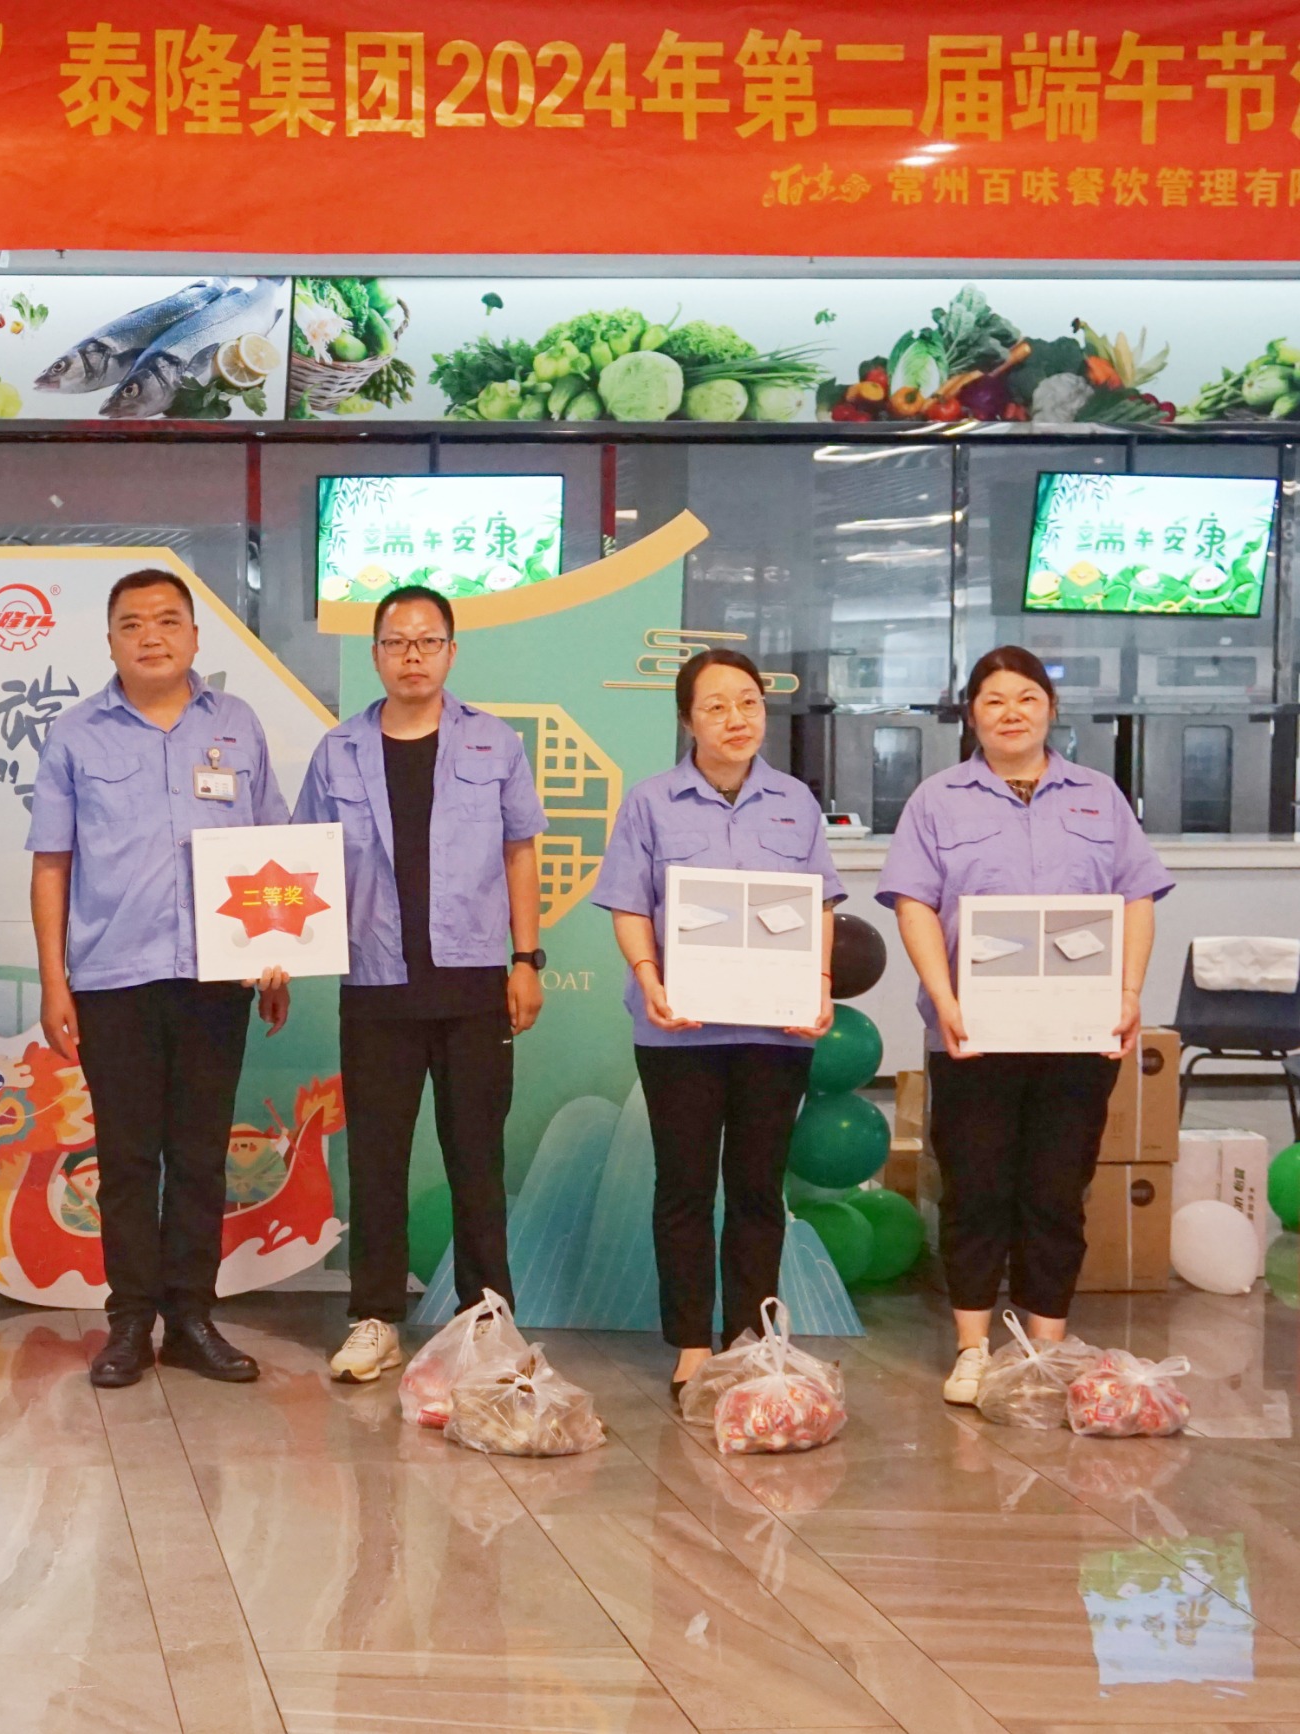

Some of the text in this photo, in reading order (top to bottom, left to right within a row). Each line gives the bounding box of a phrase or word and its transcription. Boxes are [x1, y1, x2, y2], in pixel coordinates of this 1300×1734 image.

[362, 510, 518, 558] 端午安康
[1076, 512, 1226, 559] 端午安康
[241, 885, 304, 906] 二等奖
